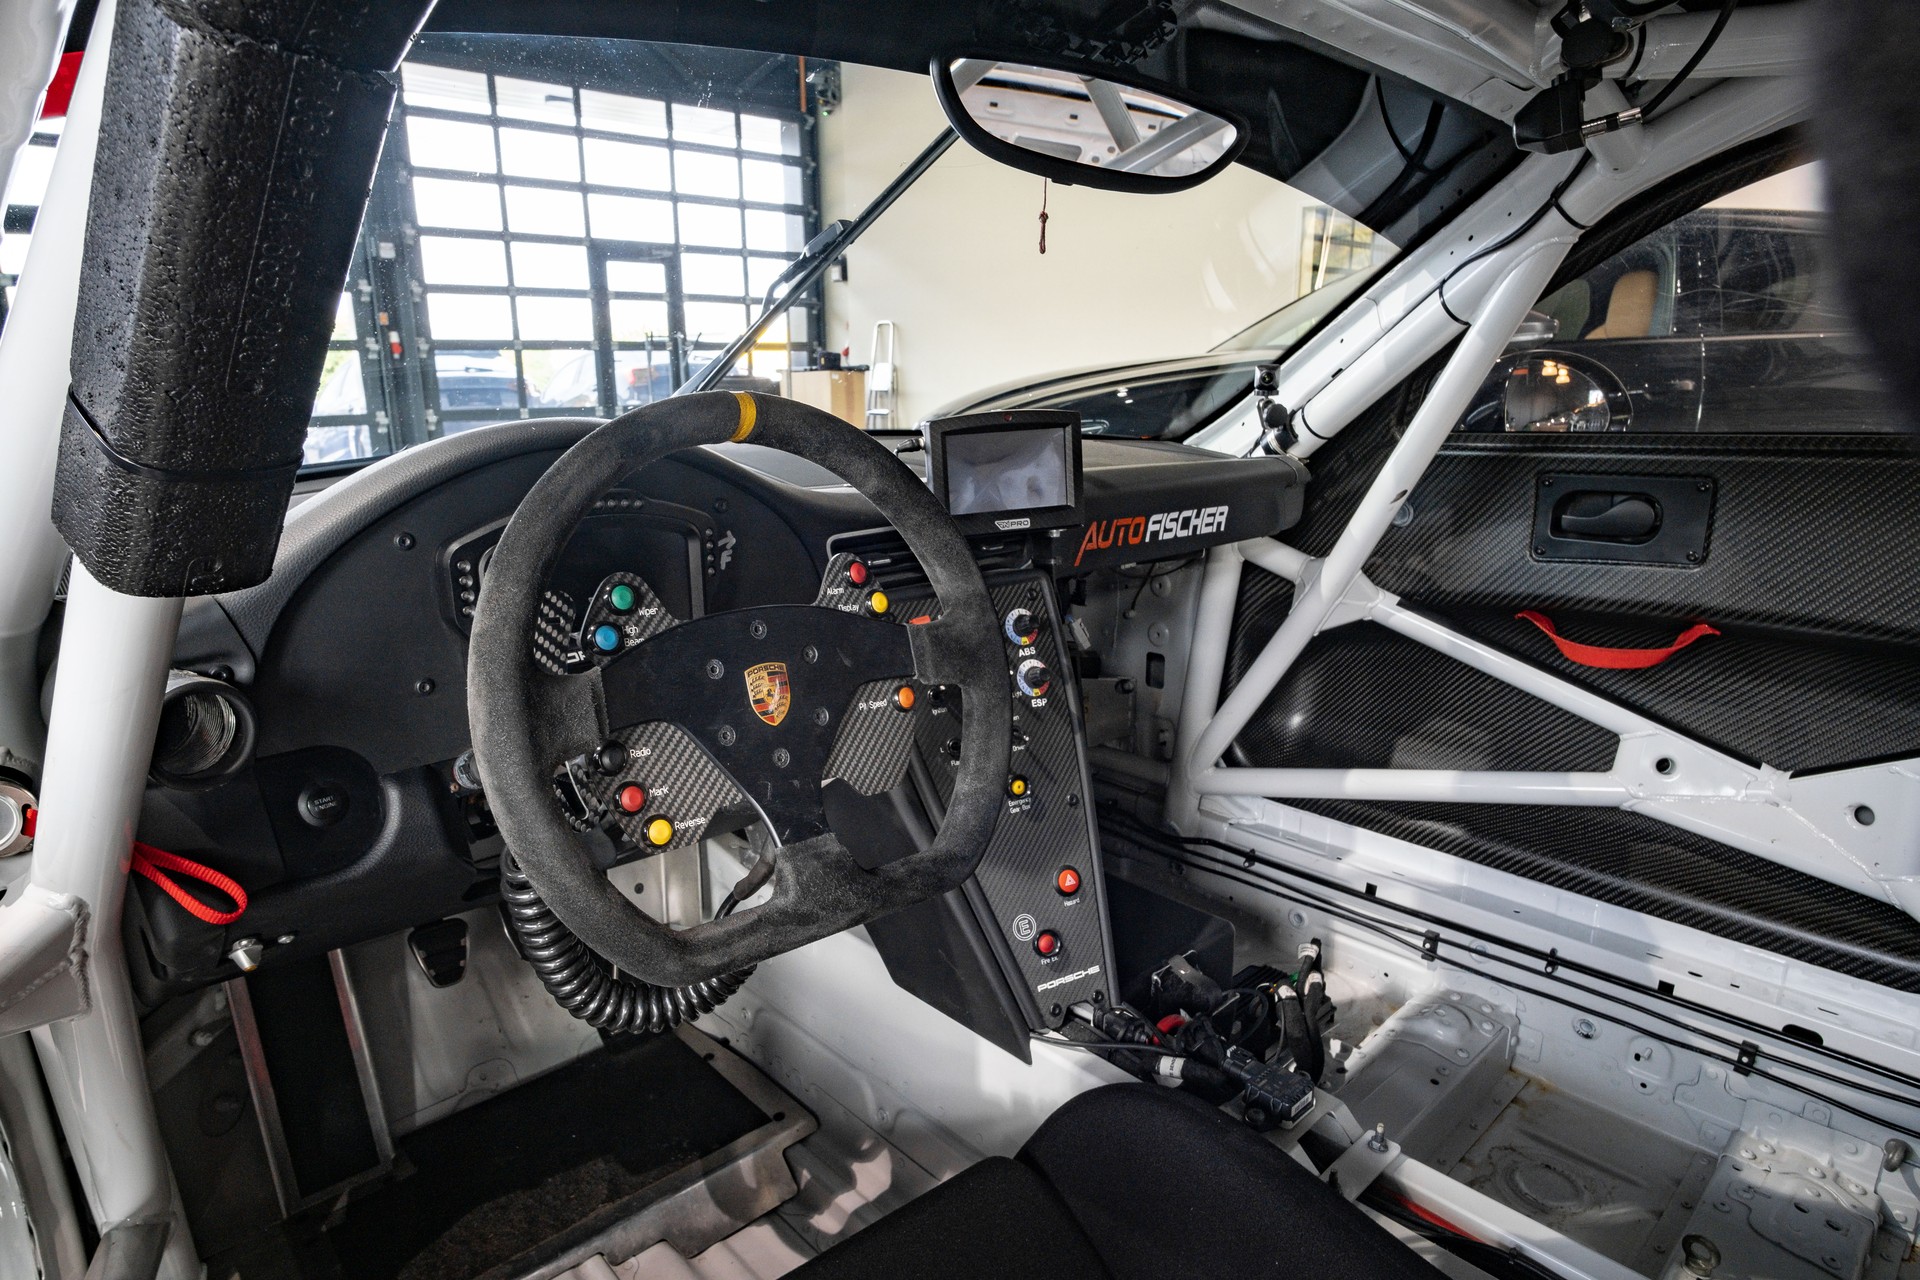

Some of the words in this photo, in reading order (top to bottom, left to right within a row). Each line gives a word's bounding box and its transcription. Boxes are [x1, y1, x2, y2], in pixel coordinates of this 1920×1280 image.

[826, 587, 844, 595] Alarm
[638, 607, 658, 618] Wiper
[838, 603, 860, 612] Display
[622, 625, 639, 637] High
[1018, 646, 1036, 658] ABS
[747, 664, 785, 677] PORSCHE
[868, 699, 888, 710] Speed
[1031, 698, 1048, 708] ESP
[629, 747, 652, 759] Radio
[648, 786, 669, 797] Mark
[674, 816, 706, 830] Reverse
[1037, 965, 1101, 993] PORSCHE
